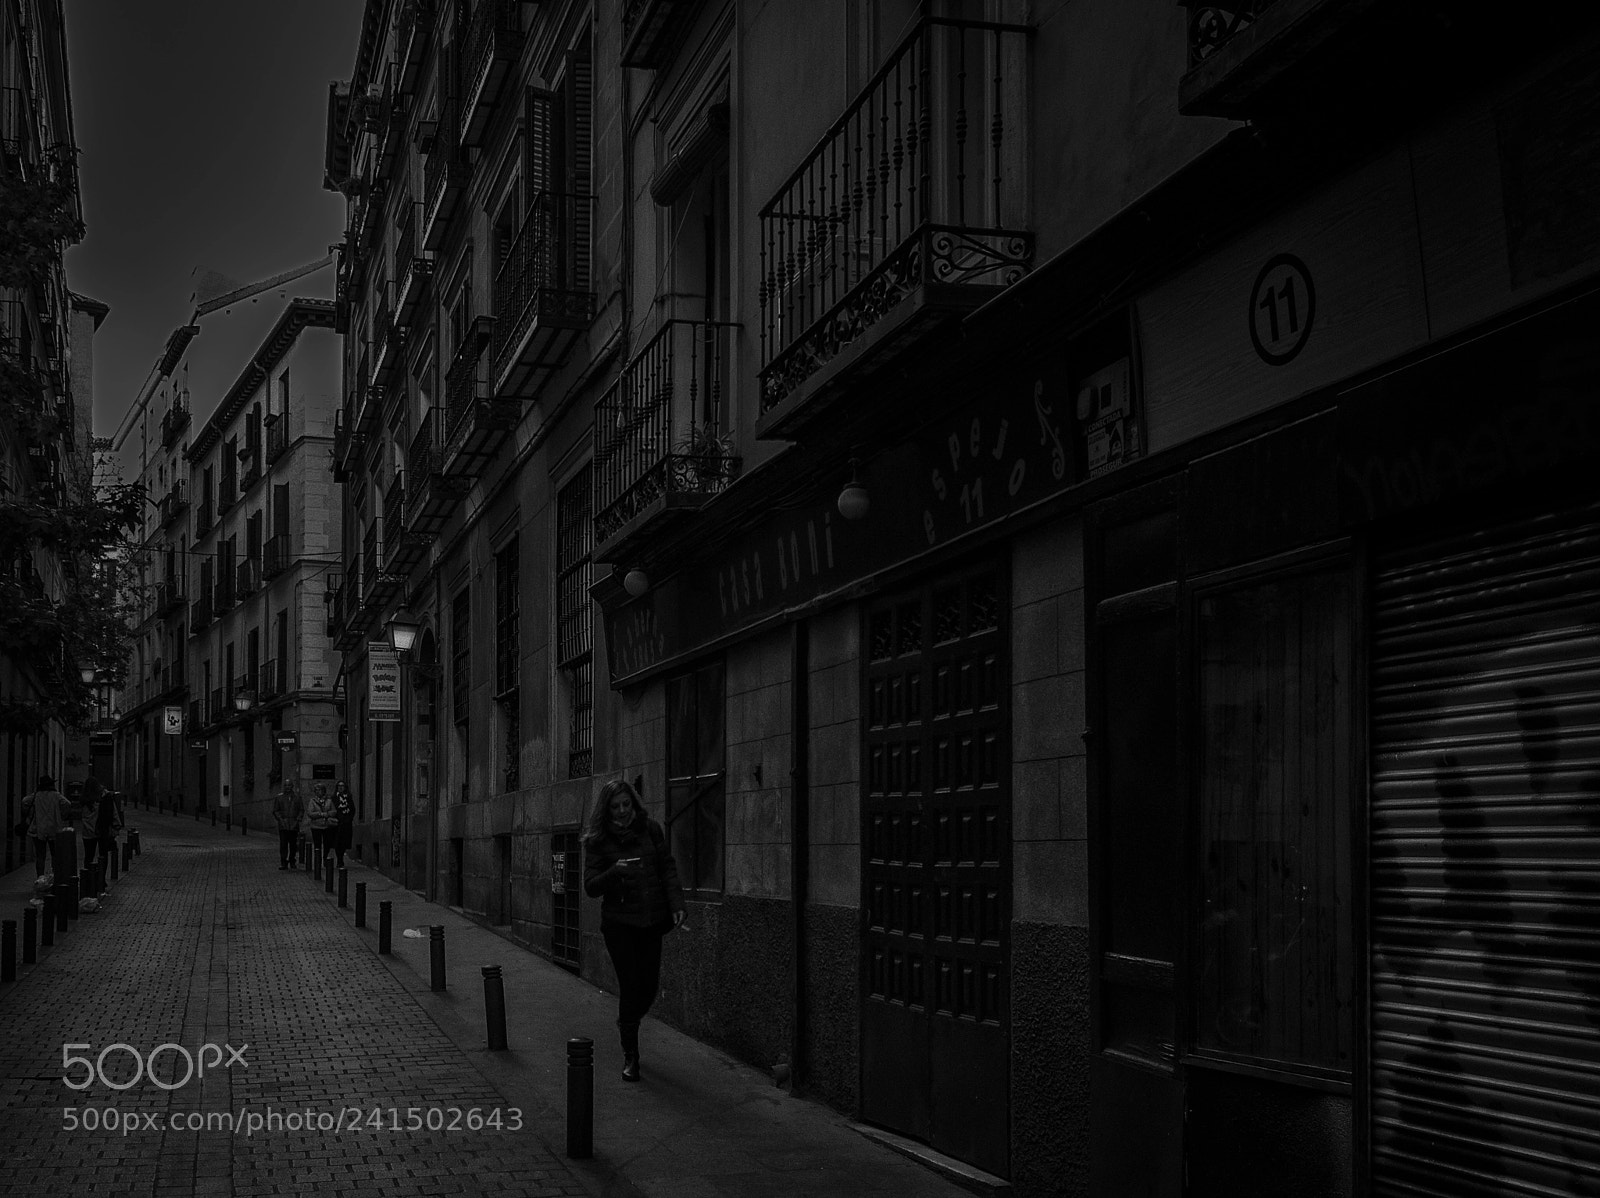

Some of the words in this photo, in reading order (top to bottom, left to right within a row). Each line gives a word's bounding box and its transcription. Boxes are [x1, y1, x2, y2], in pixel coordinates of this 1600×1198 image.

[1259, 275, 1299, 343] 11
[1088, 410, 1123, 433] CONECTADA
[1089, 457, 1123, 481] PROSEGUR
[959, 477, 984, 525] 11
